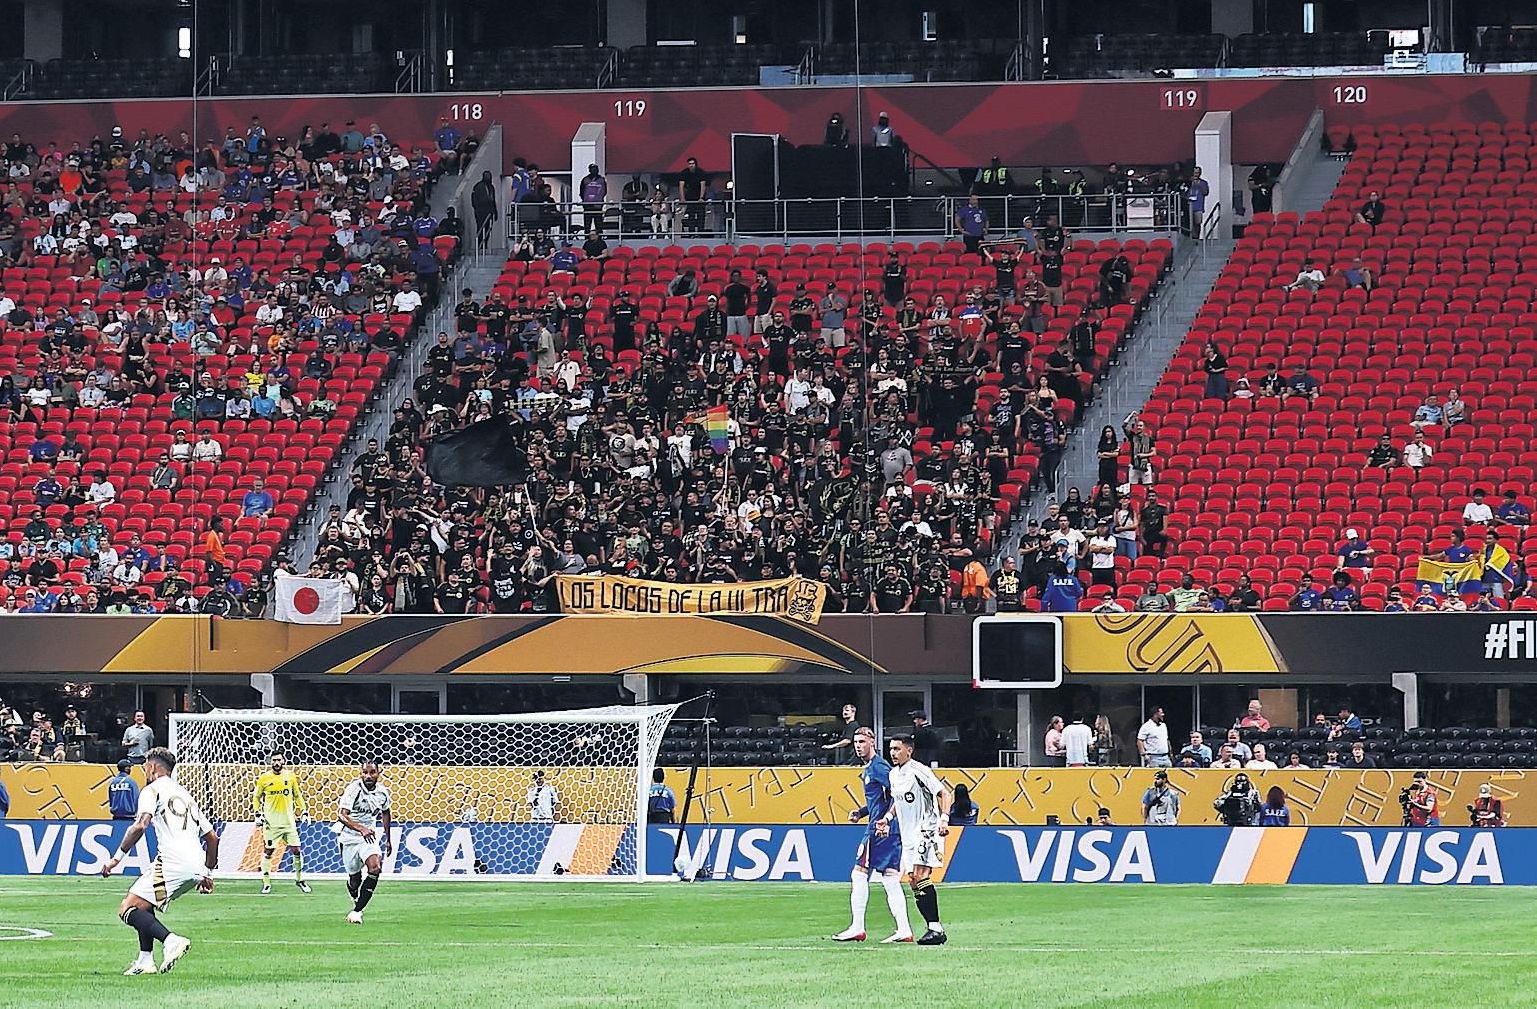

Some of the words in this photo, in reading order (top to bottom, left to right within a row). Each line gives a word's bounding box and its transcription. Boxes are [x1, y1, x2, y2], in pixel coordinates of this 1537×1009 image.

[614, 100, 646, 117] 119
[1164, 90, 1198, 107] 119
[1333, 86, 1367, 103] 120
[451, 104, 482, 120] 118
[560, 581, 594, 610] LOS
[600, 583, 661, 613] LOCOS
[668, 589, 691, 614] DE
[698, 590, 721, 614] LA
[1484, 620, 1537, 659] #FI
[658, 828, 816, 881] VISA
[996, 829, 1157, 883] VISA
[1340, 831, 1505, 885] VISA
